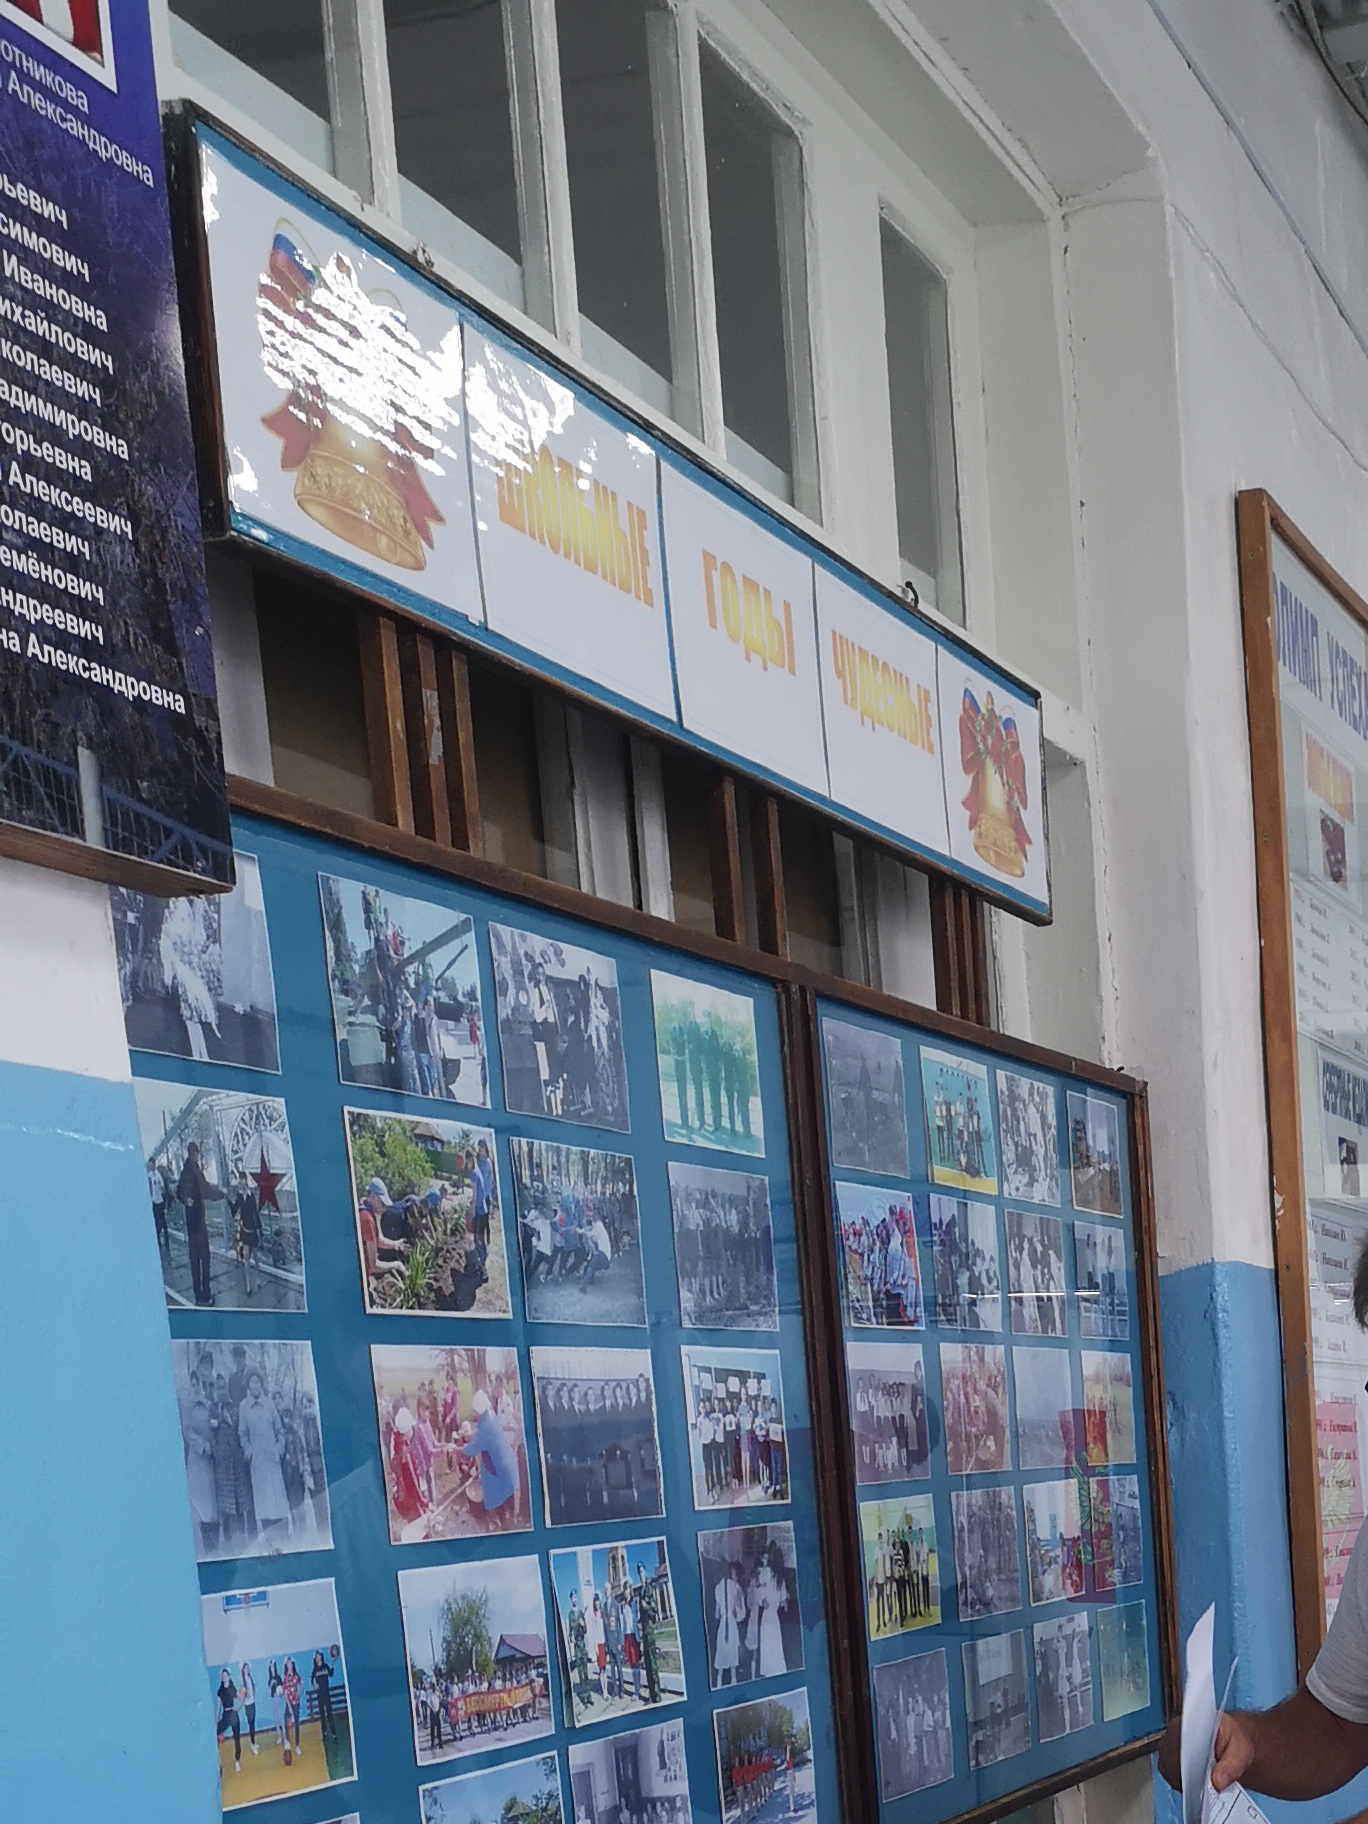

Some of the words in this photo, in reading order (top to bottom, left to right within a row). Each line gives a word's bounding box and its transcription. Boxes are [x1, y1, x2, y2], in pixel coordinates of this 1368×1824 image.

[8, 69, 154, 188] Александровна
[2, 248, 107, 332] Ивановна
[0, 420, 92, 482] орьевна
[8, 460, 133, 541] Алексеевич
[495, 444, 654, 608] ШКОЛЬНЫЕ
[701, 548, 797, 677] ГОДЫ
[830, 630, 936, 756] ЧУДЕСНЫЕ
[27, 632, 186, 714] Александровна
